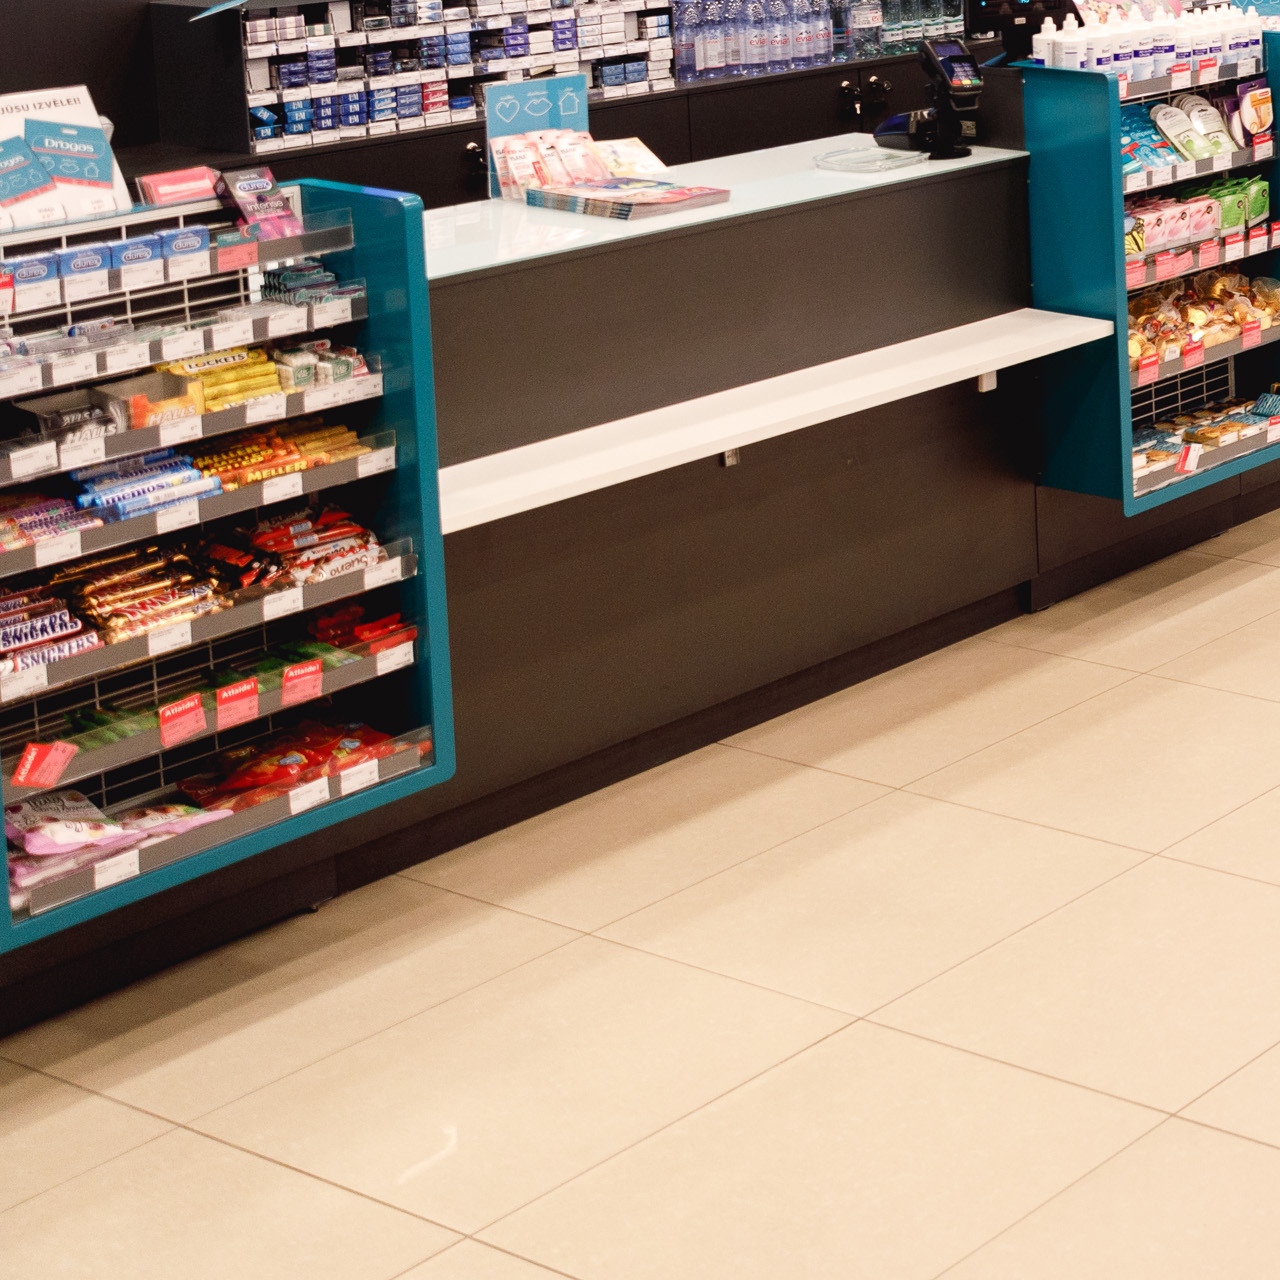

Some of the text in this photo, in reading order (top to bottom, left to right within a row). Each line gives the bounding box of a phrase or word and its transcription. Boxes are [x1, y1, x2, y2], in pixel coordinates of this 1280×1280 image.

[44, 138, 94, 153] Drogas
[0, 155, 25, 168] ogas
[240, 182, 268, 192] durex
[175, 240, 200, 250] durex
[74, 258, 99, 269] durex
[124, 250, 150, 261] durex
[18, 267, 46, 279] durex
[186, 351, 247, 372] LOCKETS
[62, 410, 91, 425] ALLS
[148, 405, 196, 427] HALLS
[66, 423, 118, 444] HALLS
[247, 460, 308, 483] MELLER
[104, 482, 166, 505] mentos
[1, 618, 79, 648] SNICKERS
[19, 633, 96, 672] SNICKERS
[287, 664, 320, 678] Atlaide!
[221, 682, 255, 699] Atlaide!
[164, 699, 199, 718] Atlaide!
[18, 747, 38, 782] Atlaide!
